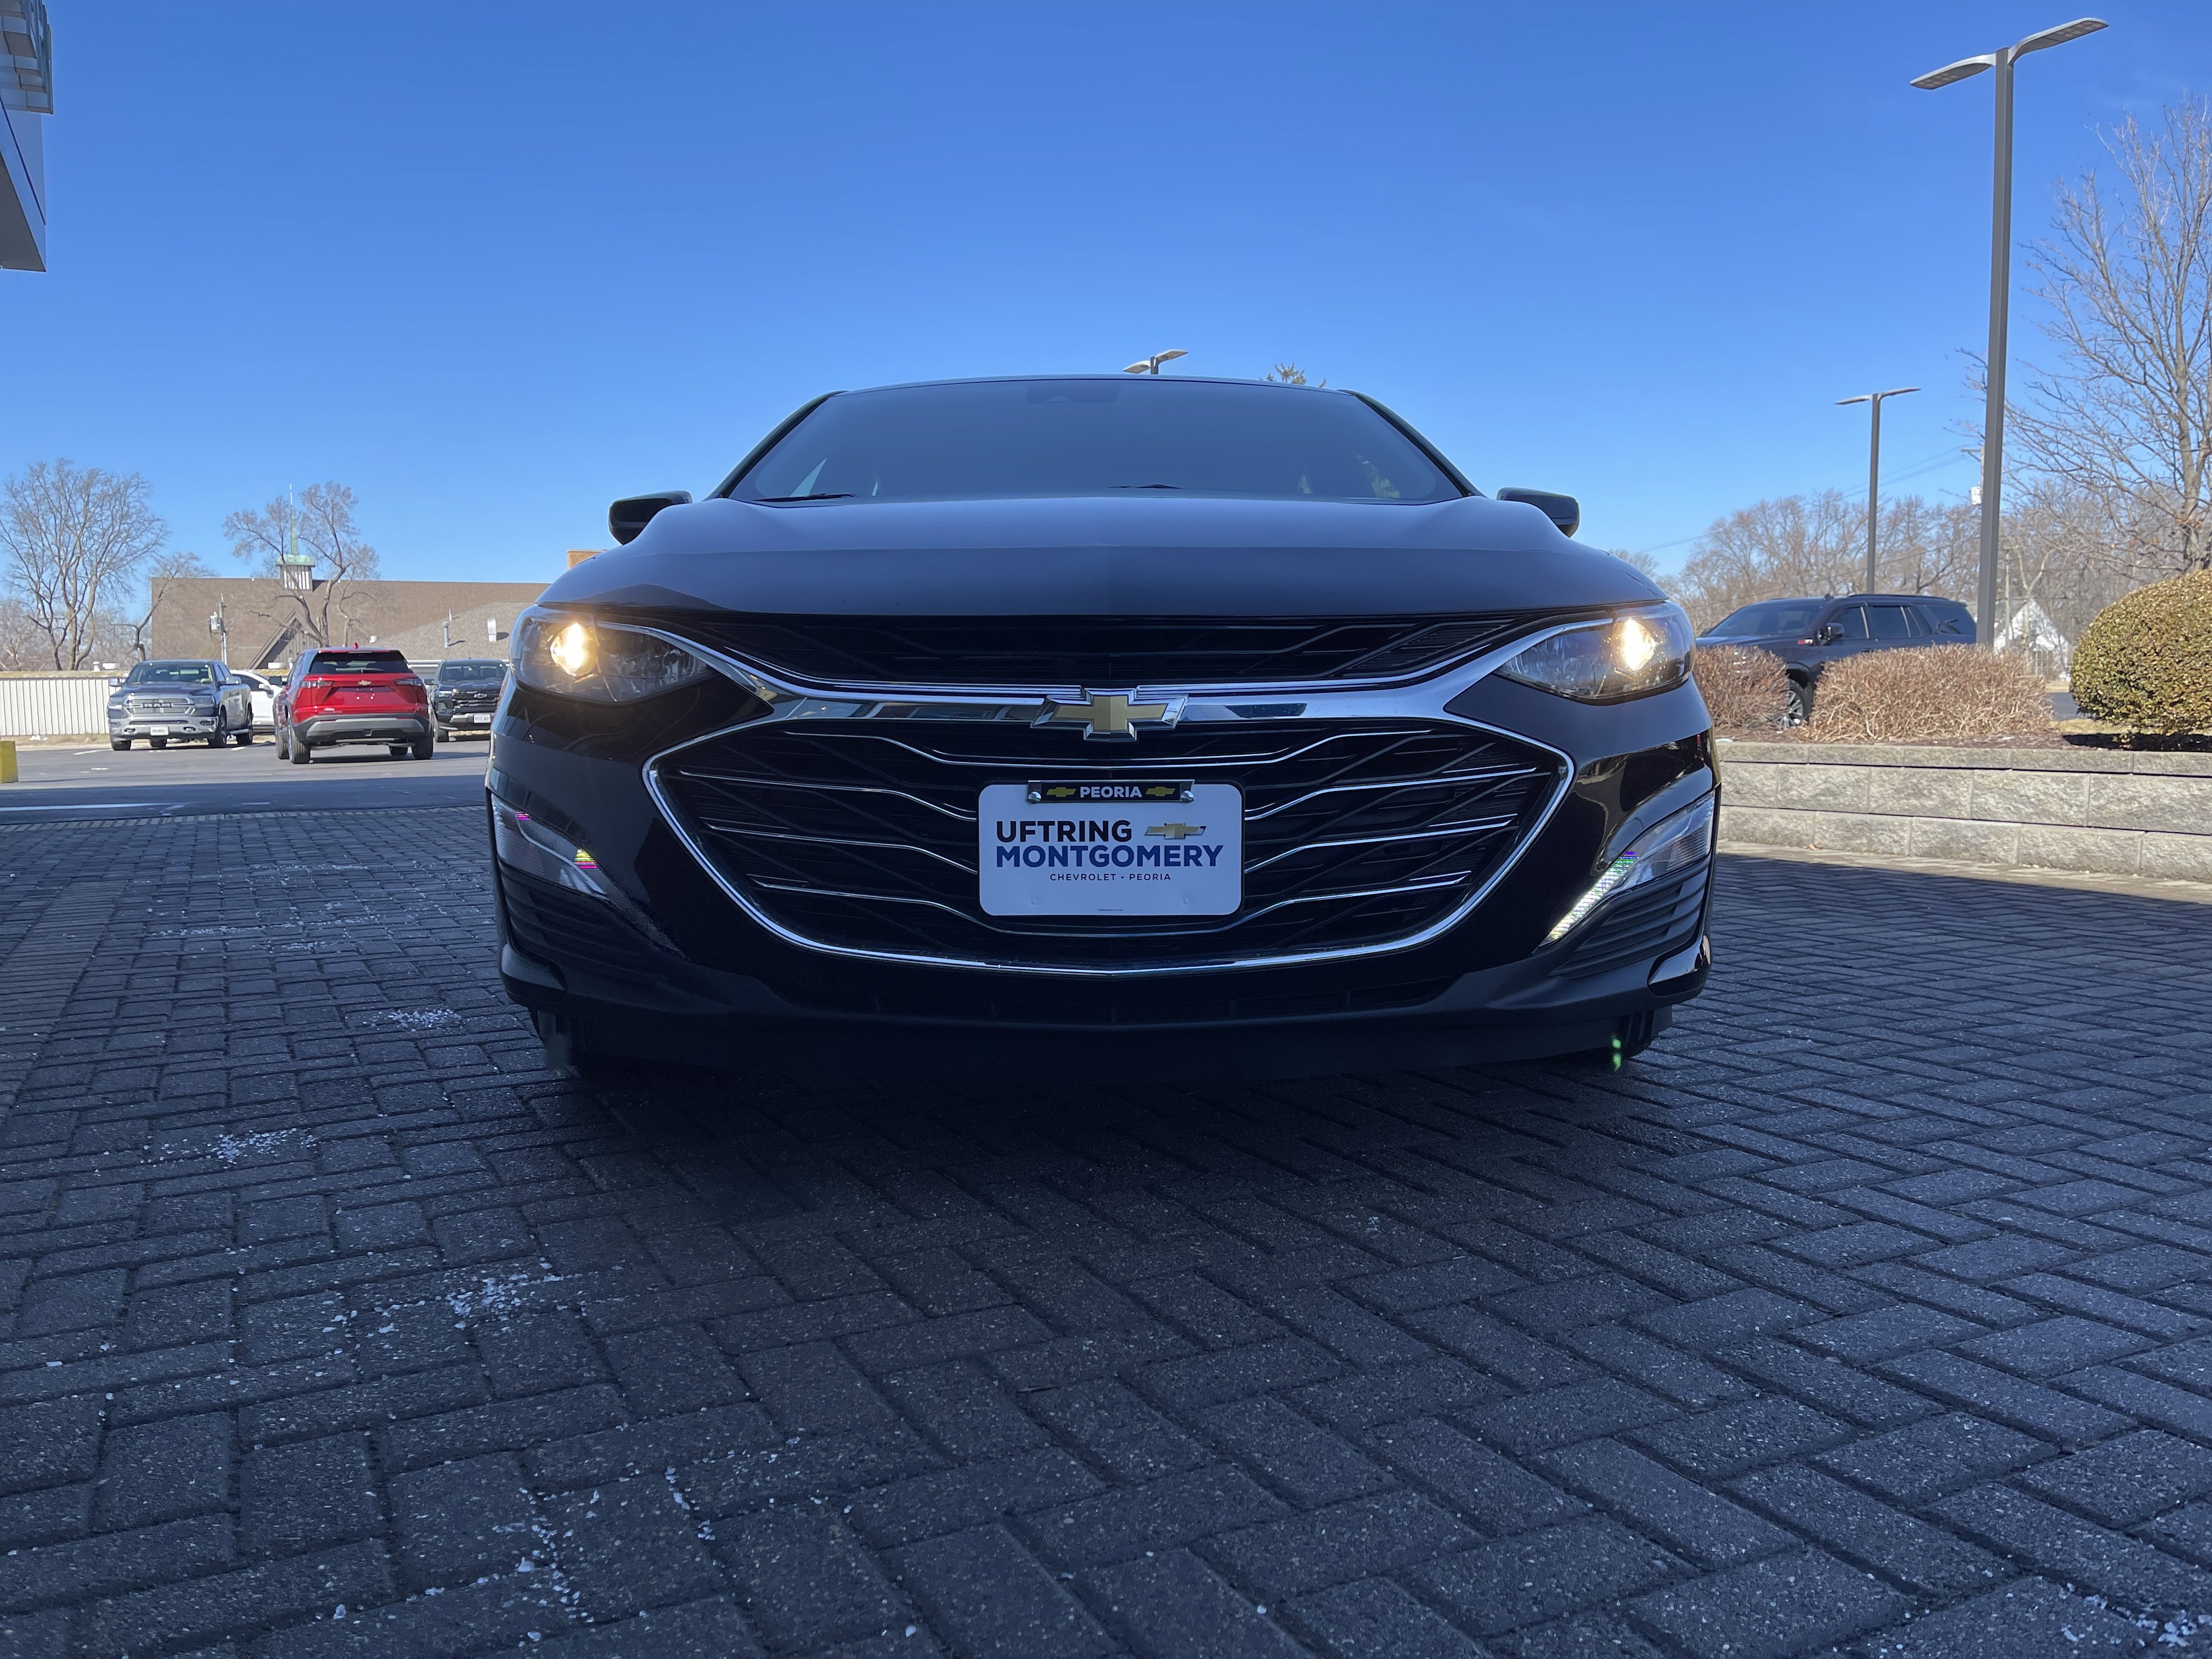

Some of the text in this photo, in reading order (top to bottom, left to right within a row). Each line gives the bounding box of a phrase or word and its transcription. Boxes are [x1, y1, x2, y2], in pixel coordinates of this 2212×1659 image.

[1080, 786, 1143, 798] PEORIA
[996, 820, 1132, 843] UFTRING
[996, 845, 1224, 868] MONTGOMERY
